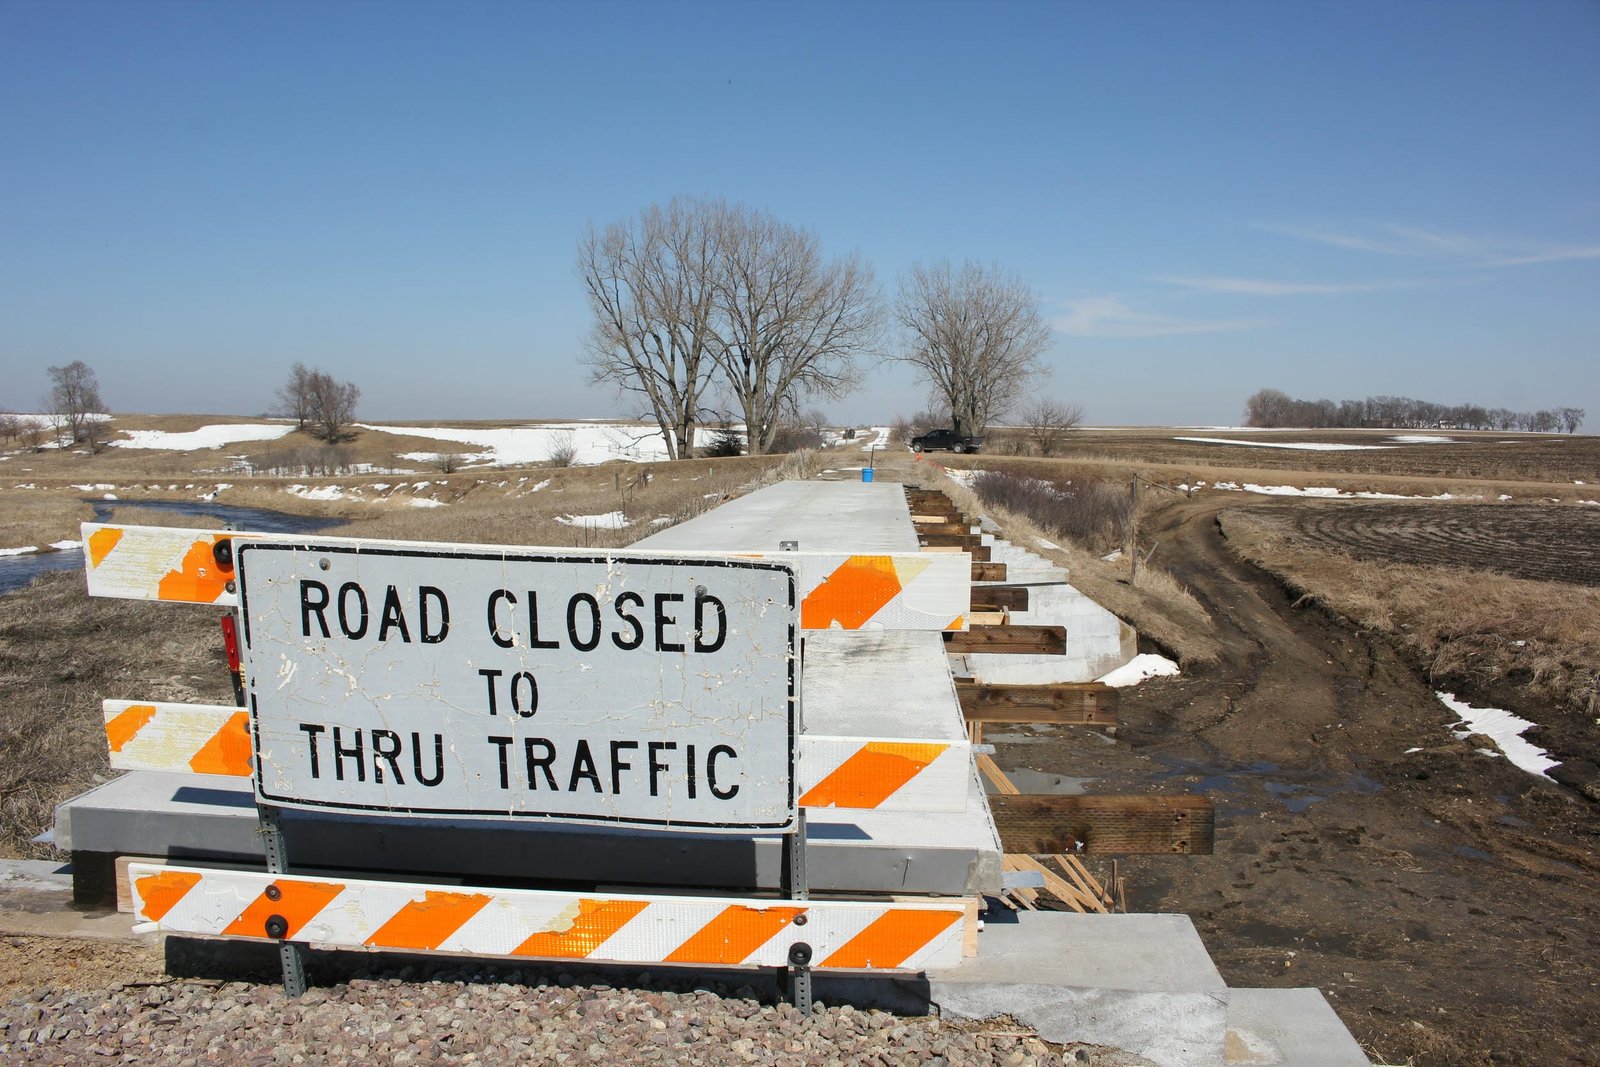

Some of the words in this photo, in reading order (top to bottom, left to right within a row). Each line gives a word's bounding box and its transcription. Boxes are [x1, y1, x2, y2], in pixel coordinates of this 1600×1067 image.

[299, 579, 450, 644] ROAD
[487, 588, 728, 654] CLOSED
[478, 668, 539, 719] TO
[299, 722, 444, 787] THRU
[487, 735, 740, 801] TRAFFIC
